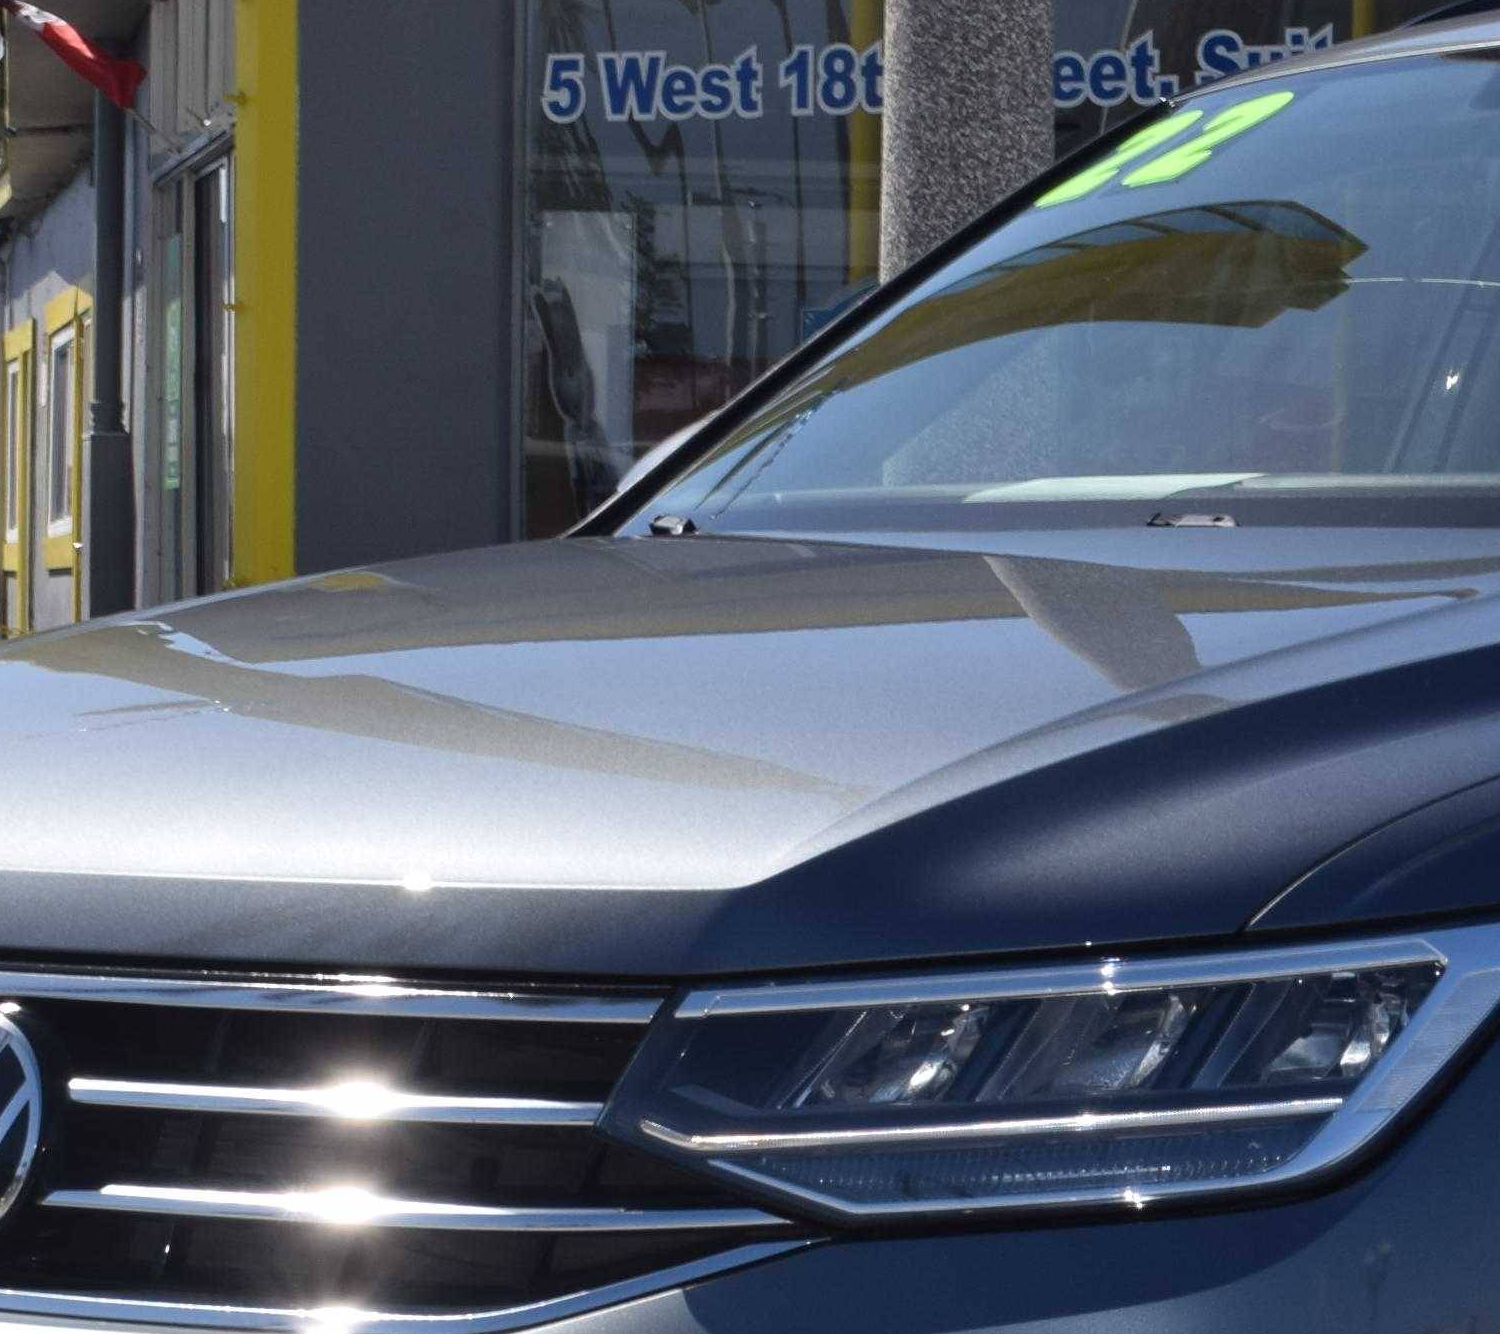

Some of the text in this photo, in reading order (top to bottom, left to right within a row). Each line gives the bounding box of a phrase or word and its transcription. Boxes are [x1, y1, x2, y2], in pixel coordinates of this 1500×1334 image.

[542, 53, 587, 124] 5
[597, 46, 763, 121] West
[779, 43, 884, 116] 18t
